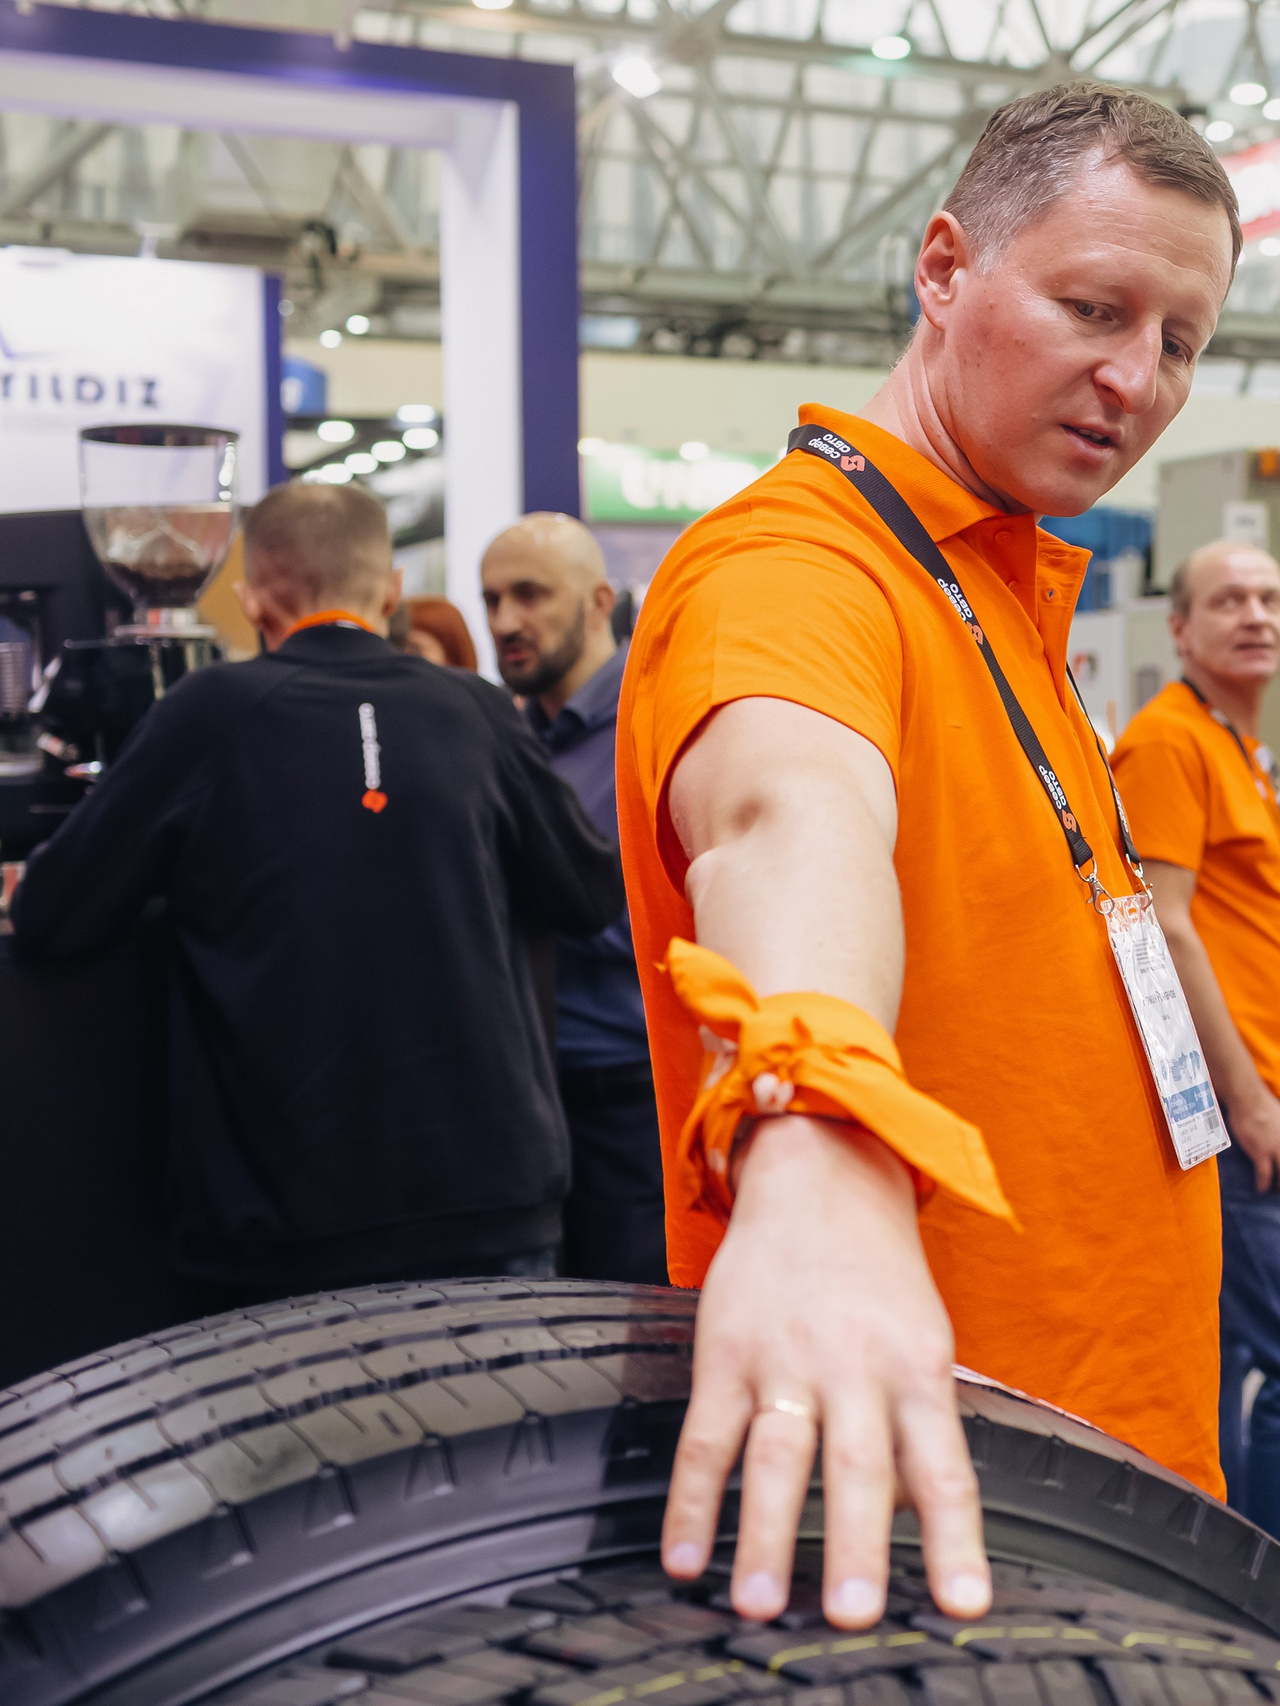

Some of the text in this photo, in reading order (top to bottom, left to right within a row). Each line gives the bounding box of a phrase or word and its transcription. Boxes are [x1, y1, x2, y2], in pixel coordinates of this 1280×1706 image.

[808, 437, 841, 459] север
[822, 433, 851, 453] авто
[937, 578, 967, 622] север
[950, 583, 973, 618] авто
[1038, 765, 1062, 810] север
[1048, 770, 1067, 806] авто
